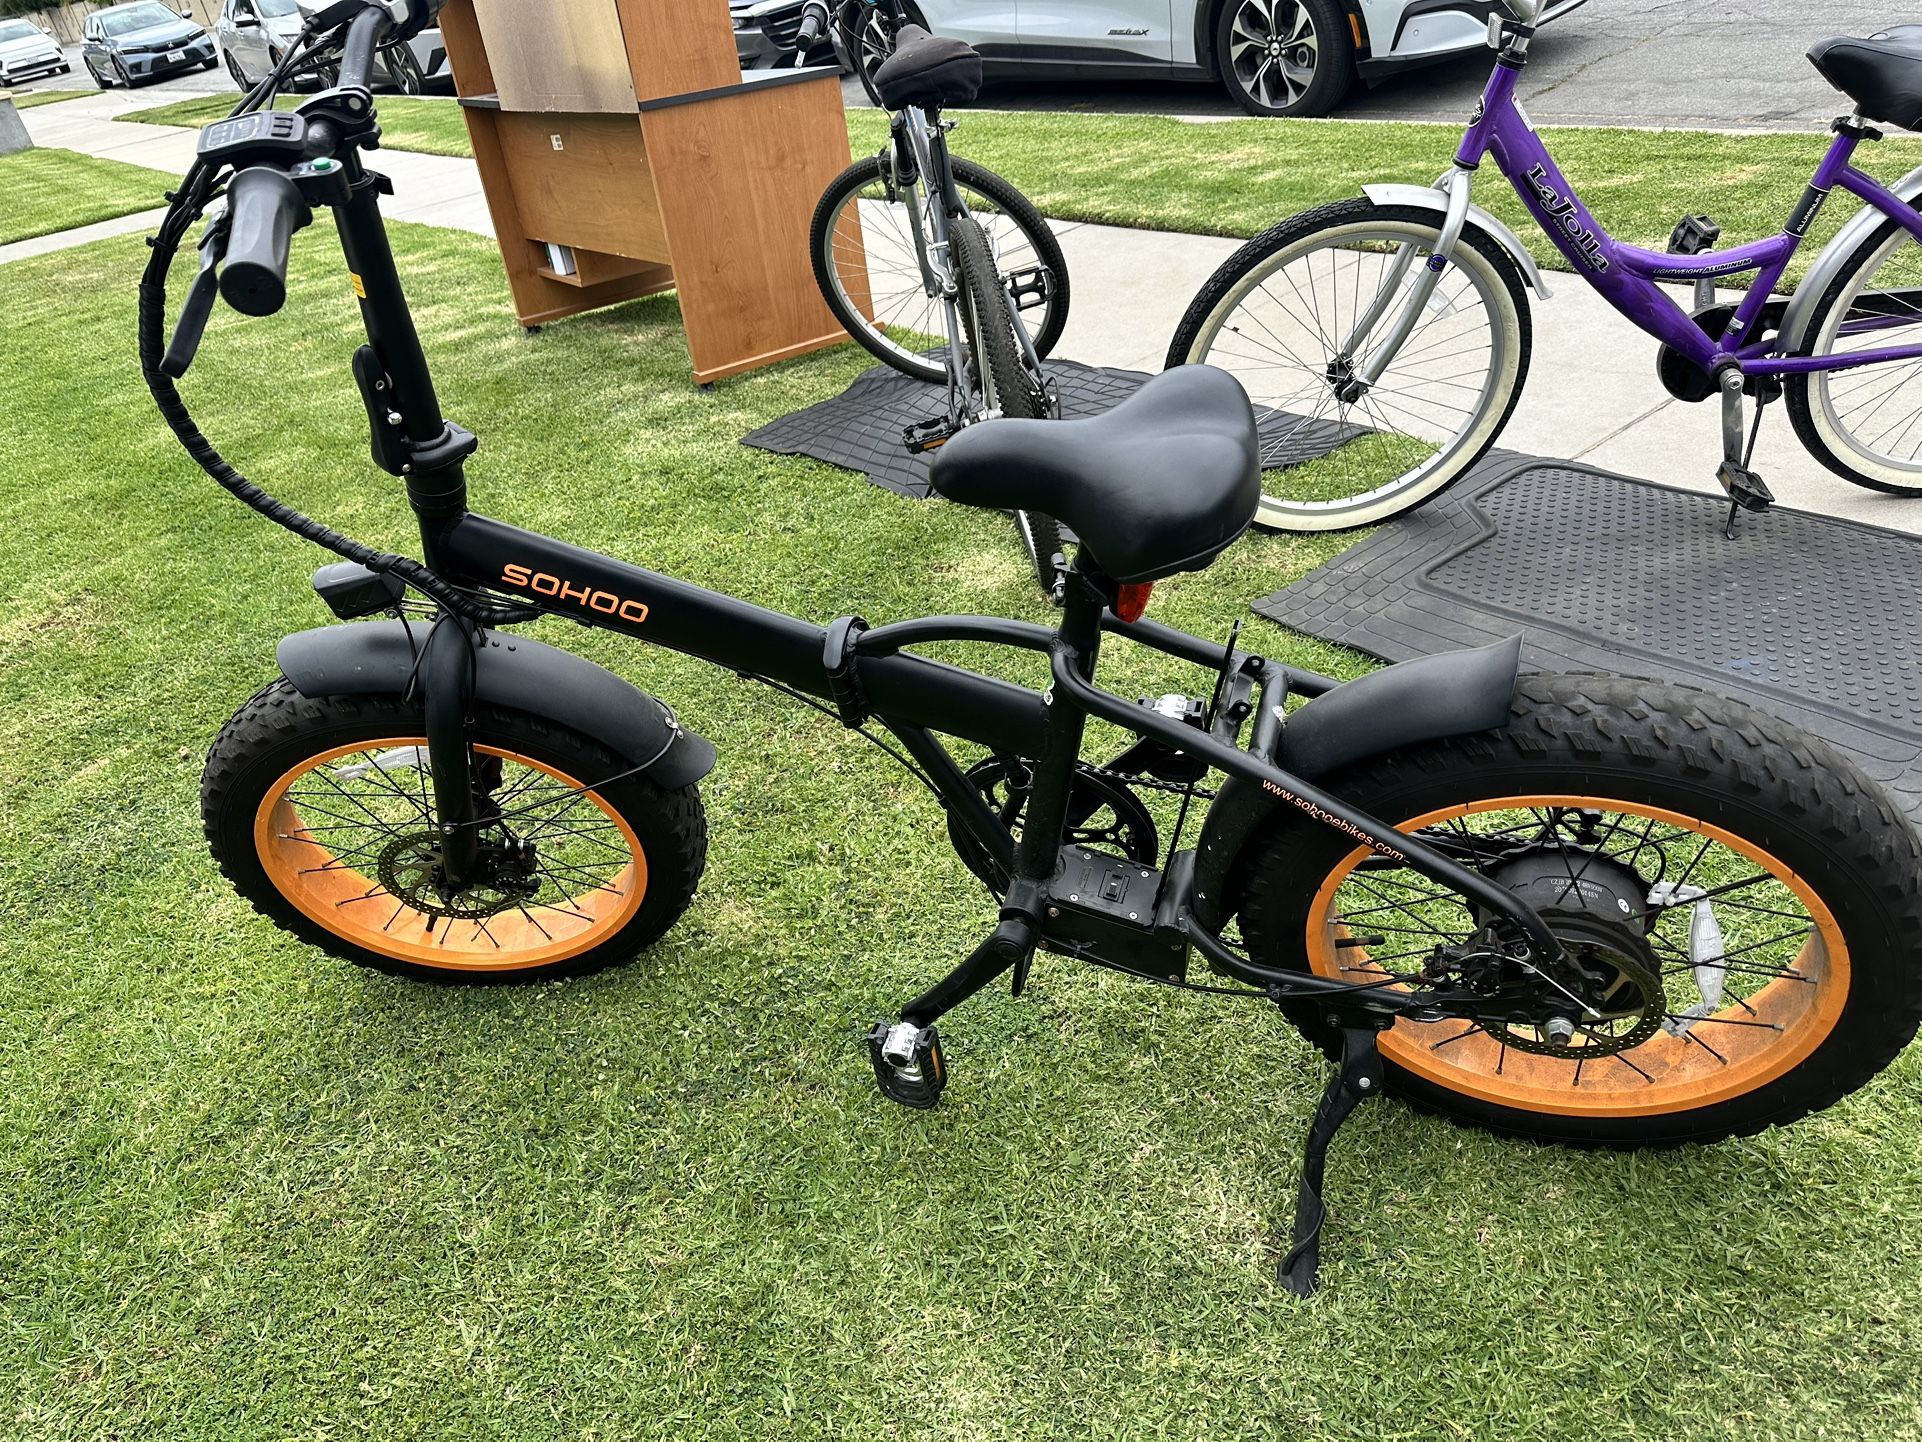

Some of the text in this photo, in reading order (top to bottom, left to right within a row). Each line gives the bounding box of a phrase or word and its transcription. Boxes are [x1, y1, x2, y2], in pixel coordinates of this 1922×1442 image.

[1796, 193, 1823, 232] ALUMINUM
[1552, 218, 1592, 269] STREET CRUISER
[1703, 258, 1752, 273] ALUMINUM
[501, 563, 649, 623] SOHOO
